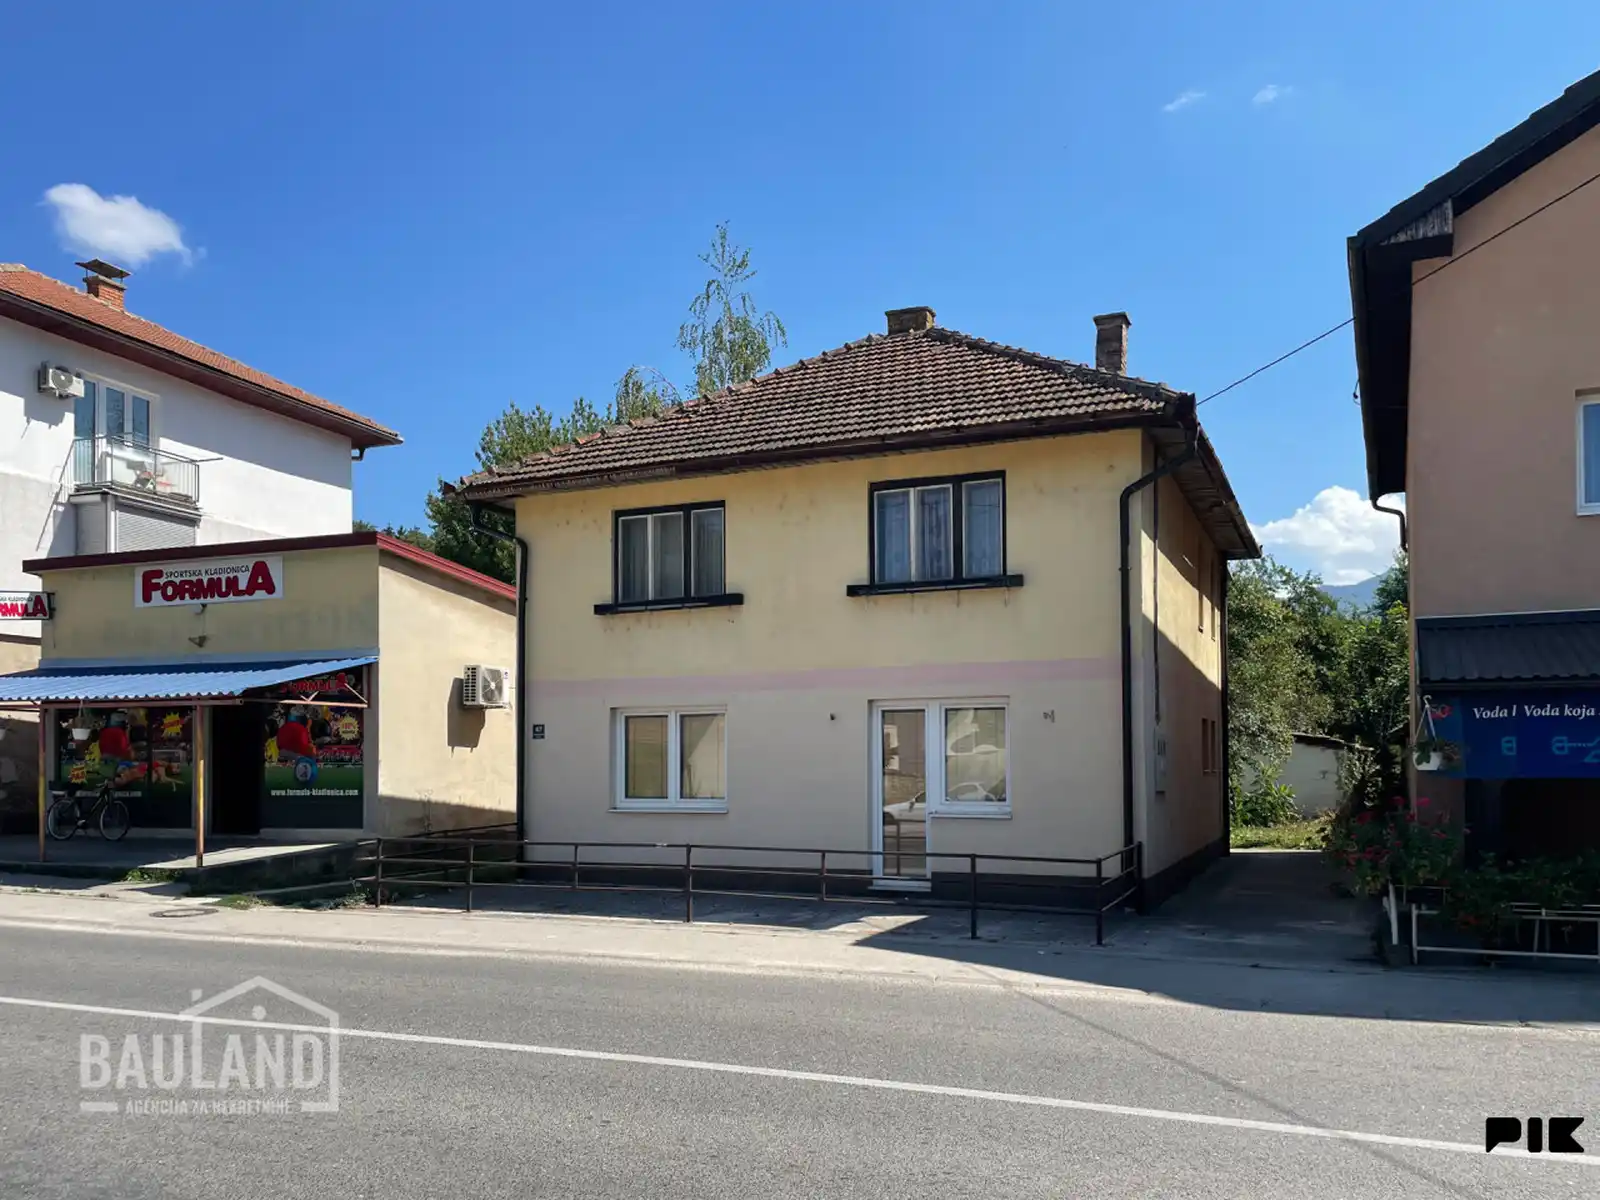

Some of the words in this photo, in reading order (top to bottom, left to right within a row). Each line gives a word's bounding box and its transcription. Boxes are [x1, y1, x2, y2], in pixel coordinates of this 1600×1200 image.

[164, 568, 203, 579] SPORTSKA
[204, 564, 251, 576] KLADIONICA
[142, 560, 276, 603] FORMULA
[1473, 705, 1508, 719] Voda
[1524, 704, 1560, 717] Voda
[1564, 704, 1595, 720] koja
